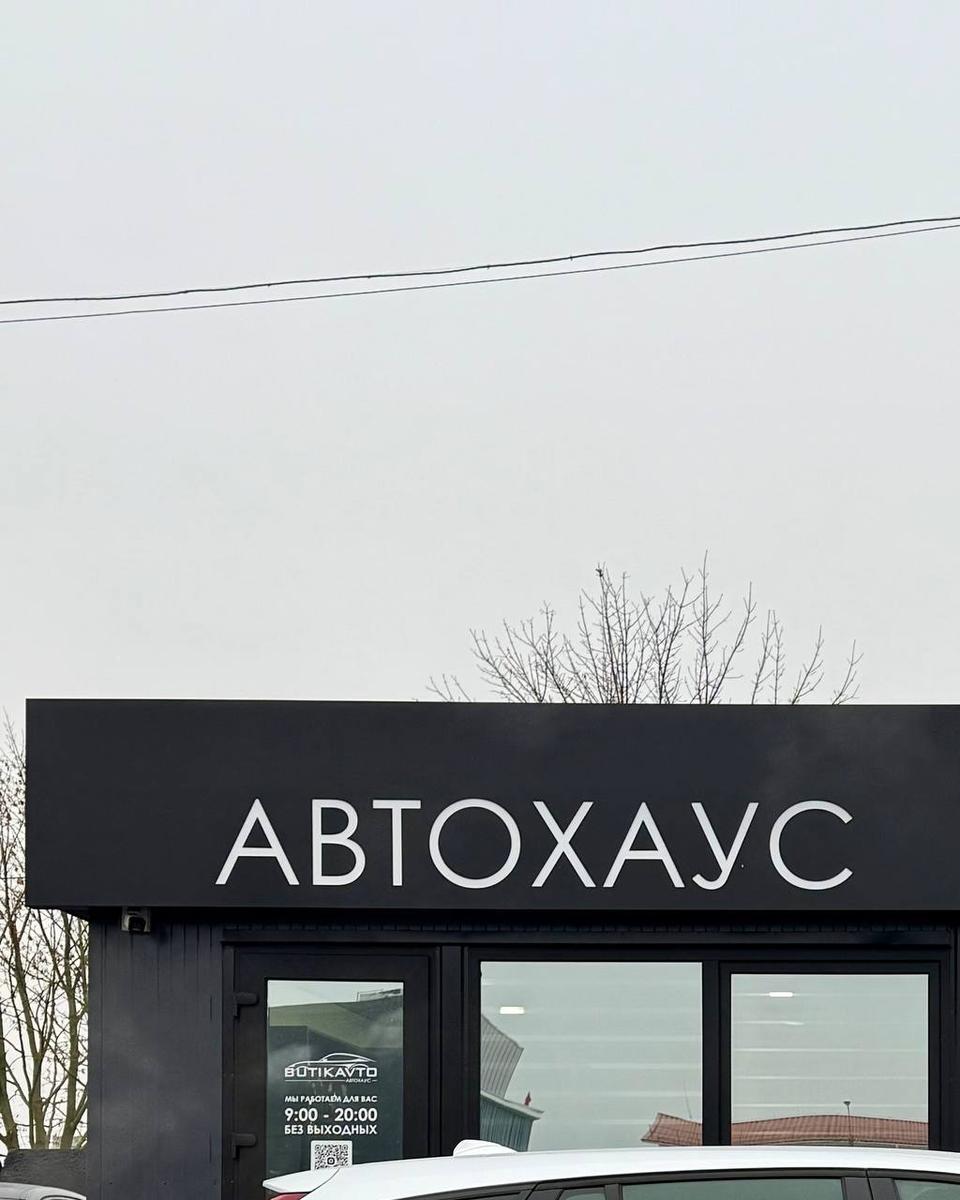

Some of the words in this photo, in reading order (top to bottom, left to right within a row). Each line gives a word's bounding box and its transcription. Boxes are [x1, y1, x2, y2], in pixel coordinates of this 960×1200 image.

[215, 797, 854, 891] АВТОХАУС
[284, 1066, 378, 1078] BUTIKAVTO
[361, 1095, 378, 1103] ВАС
[284, 1108, 319, 1122] 9:00
[334, 1108, 378, 1122] 20:00
[284, 1124, 304, 1135] БЕЗ
[306, 1124, 378, 1136] ВЫХОДНЫХ
